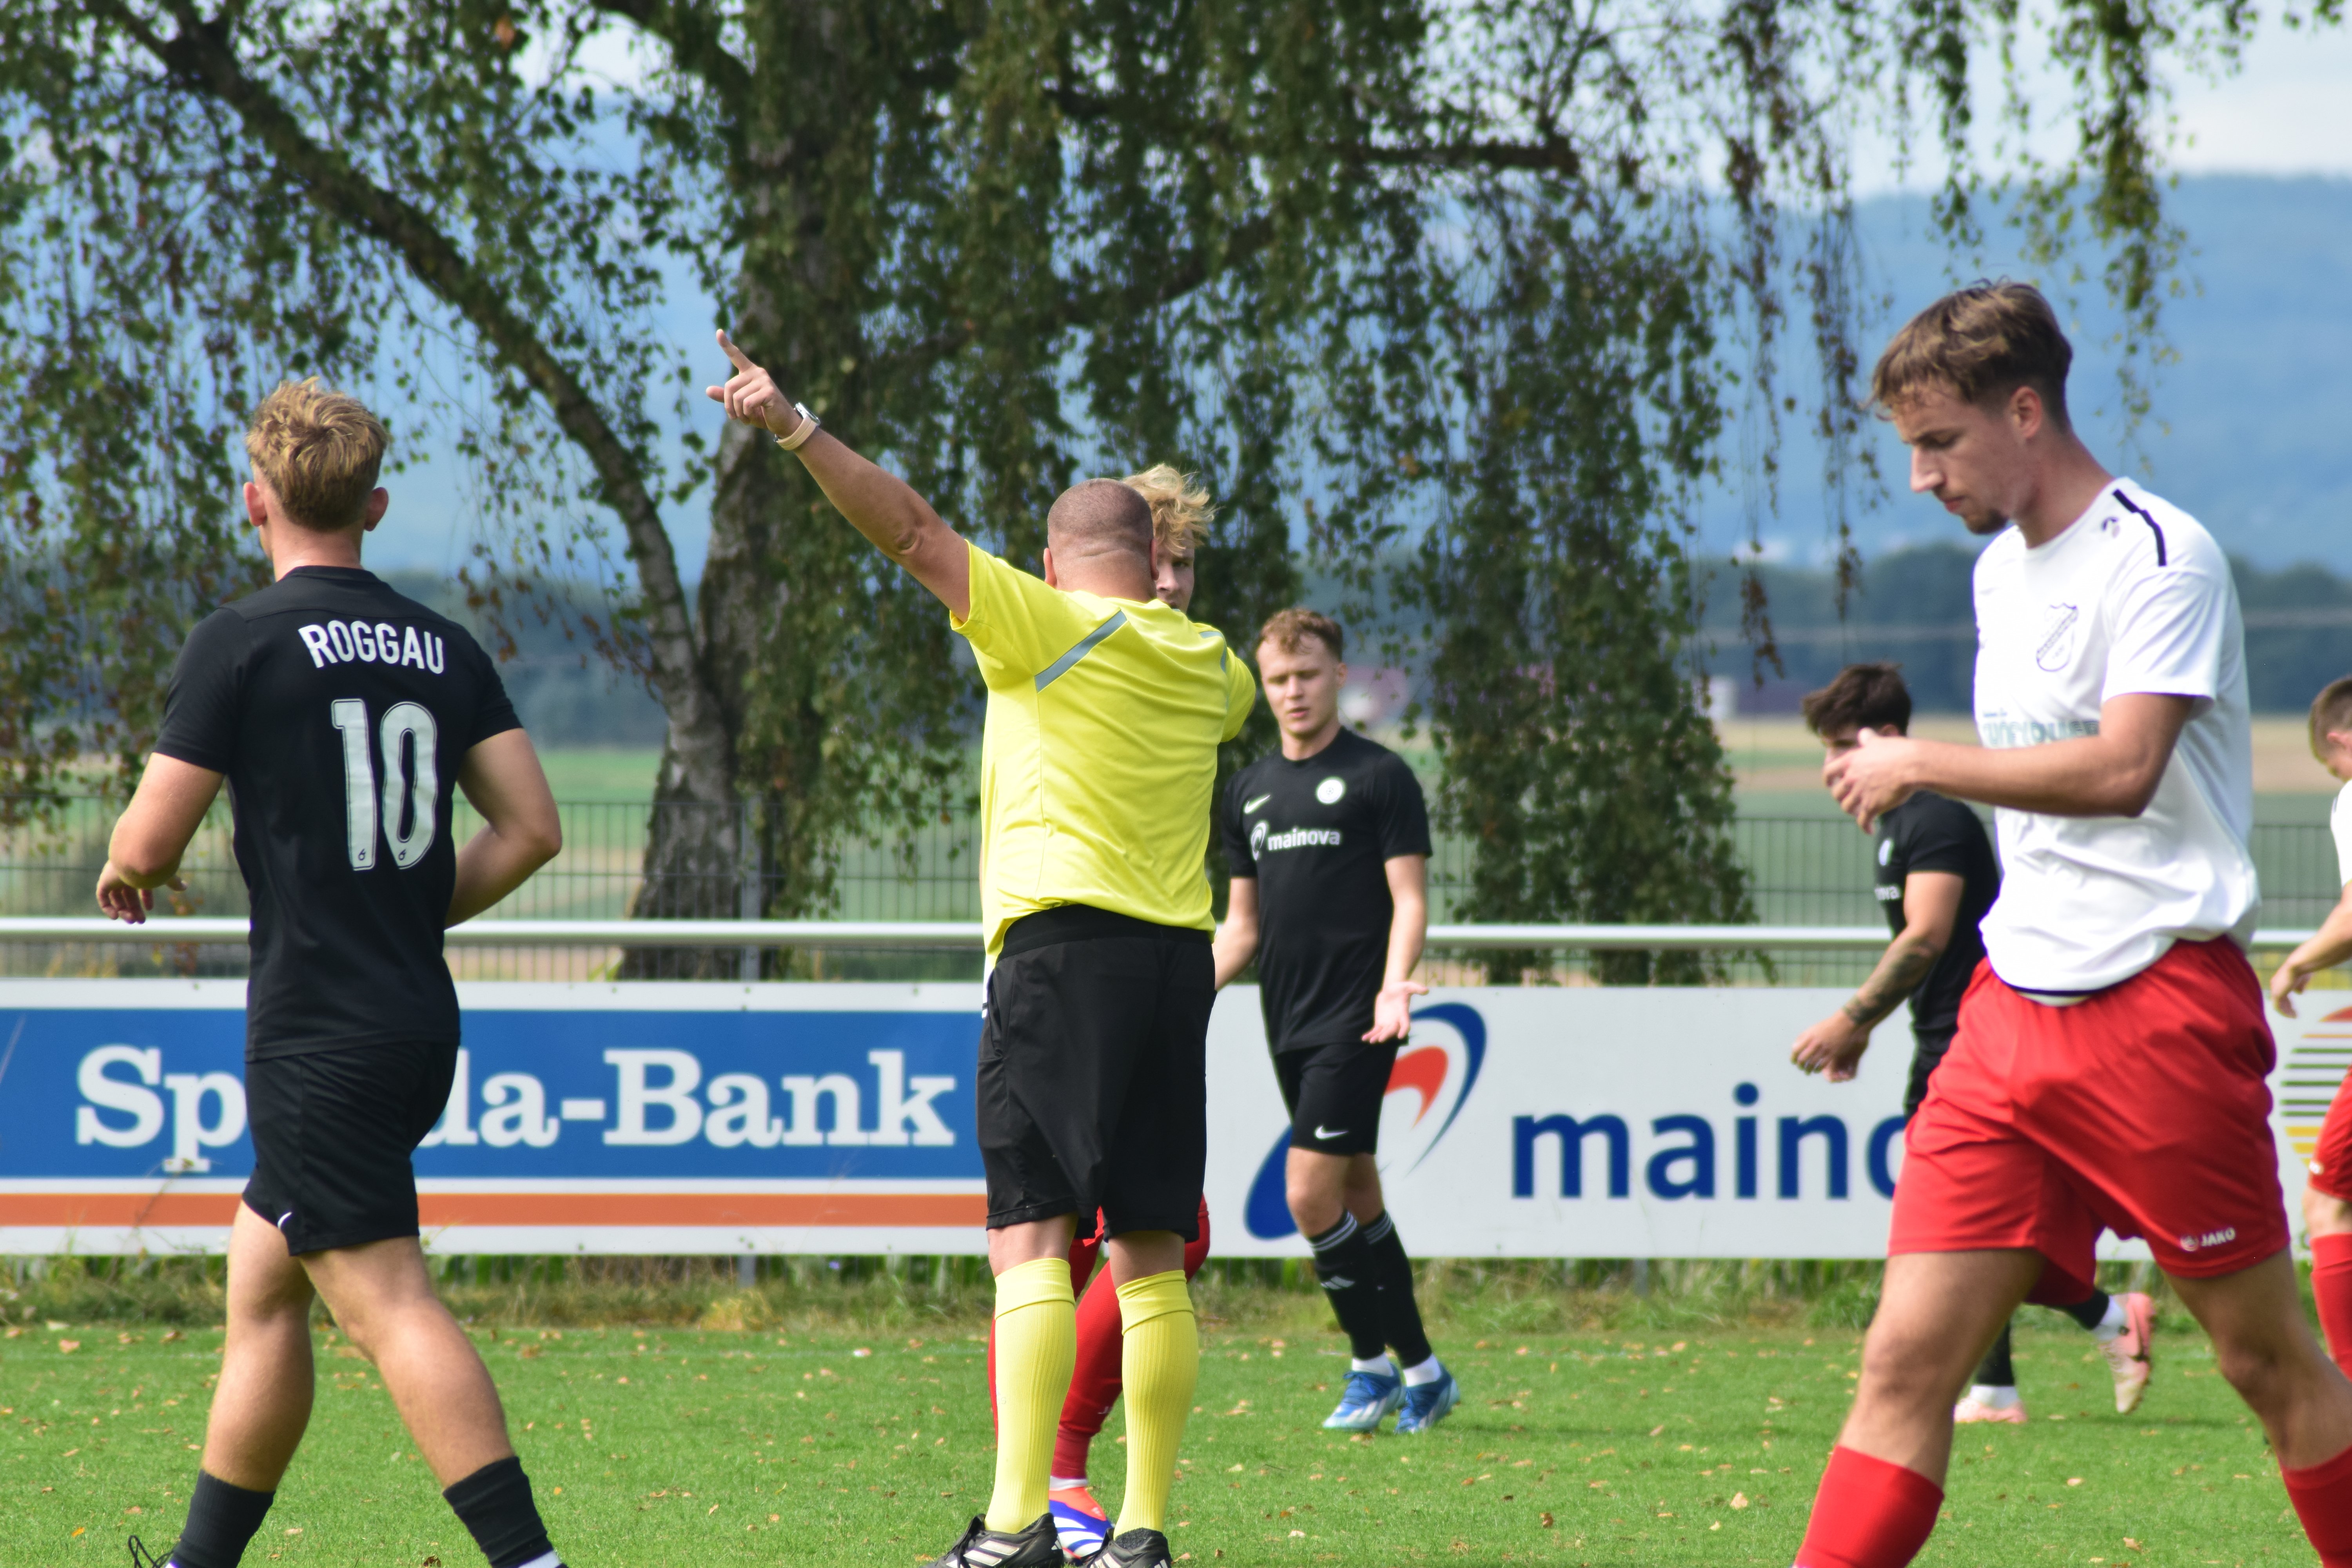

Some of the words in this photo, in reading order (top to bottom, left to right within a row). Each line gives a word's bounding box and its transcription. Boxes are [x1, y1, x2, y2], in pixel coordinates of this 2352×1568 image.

[298, 620, 444, 674] ROGGAU
[331, 699, 437, 871] 10
[1268, 827, 1340, 851] mainova
[76, 1044, 956, 1172] Spda-Bank
[2201, 1227, 2236, 1247] JAKO
